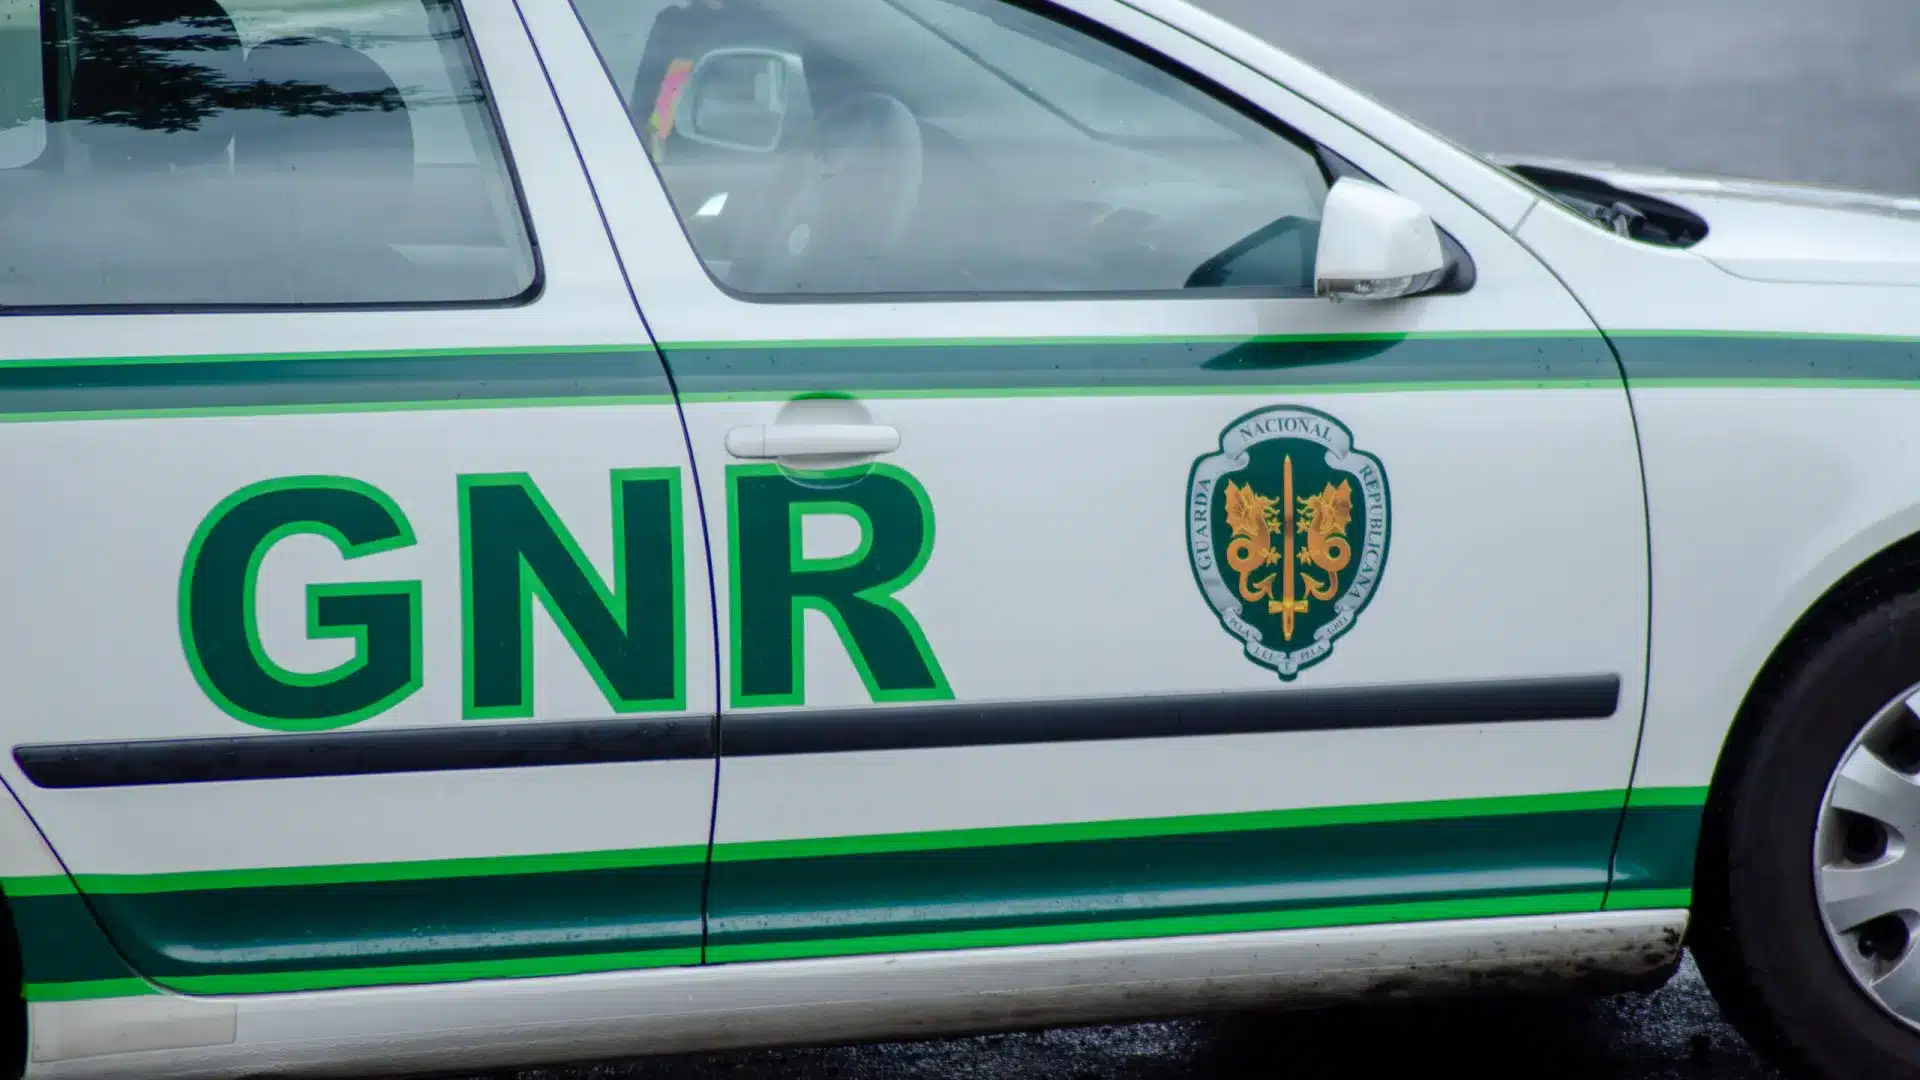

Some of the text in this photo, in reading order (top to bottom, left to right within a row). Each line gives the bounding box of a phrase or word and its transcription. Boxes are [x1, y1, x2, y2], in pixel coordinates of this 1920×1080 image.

[178, 463, 956, 731] GNR
[1193, 417, 1384, 600] GUARDA NACIONAL REPUBLICANA
[1300, 645, 1325, 660] PELA
